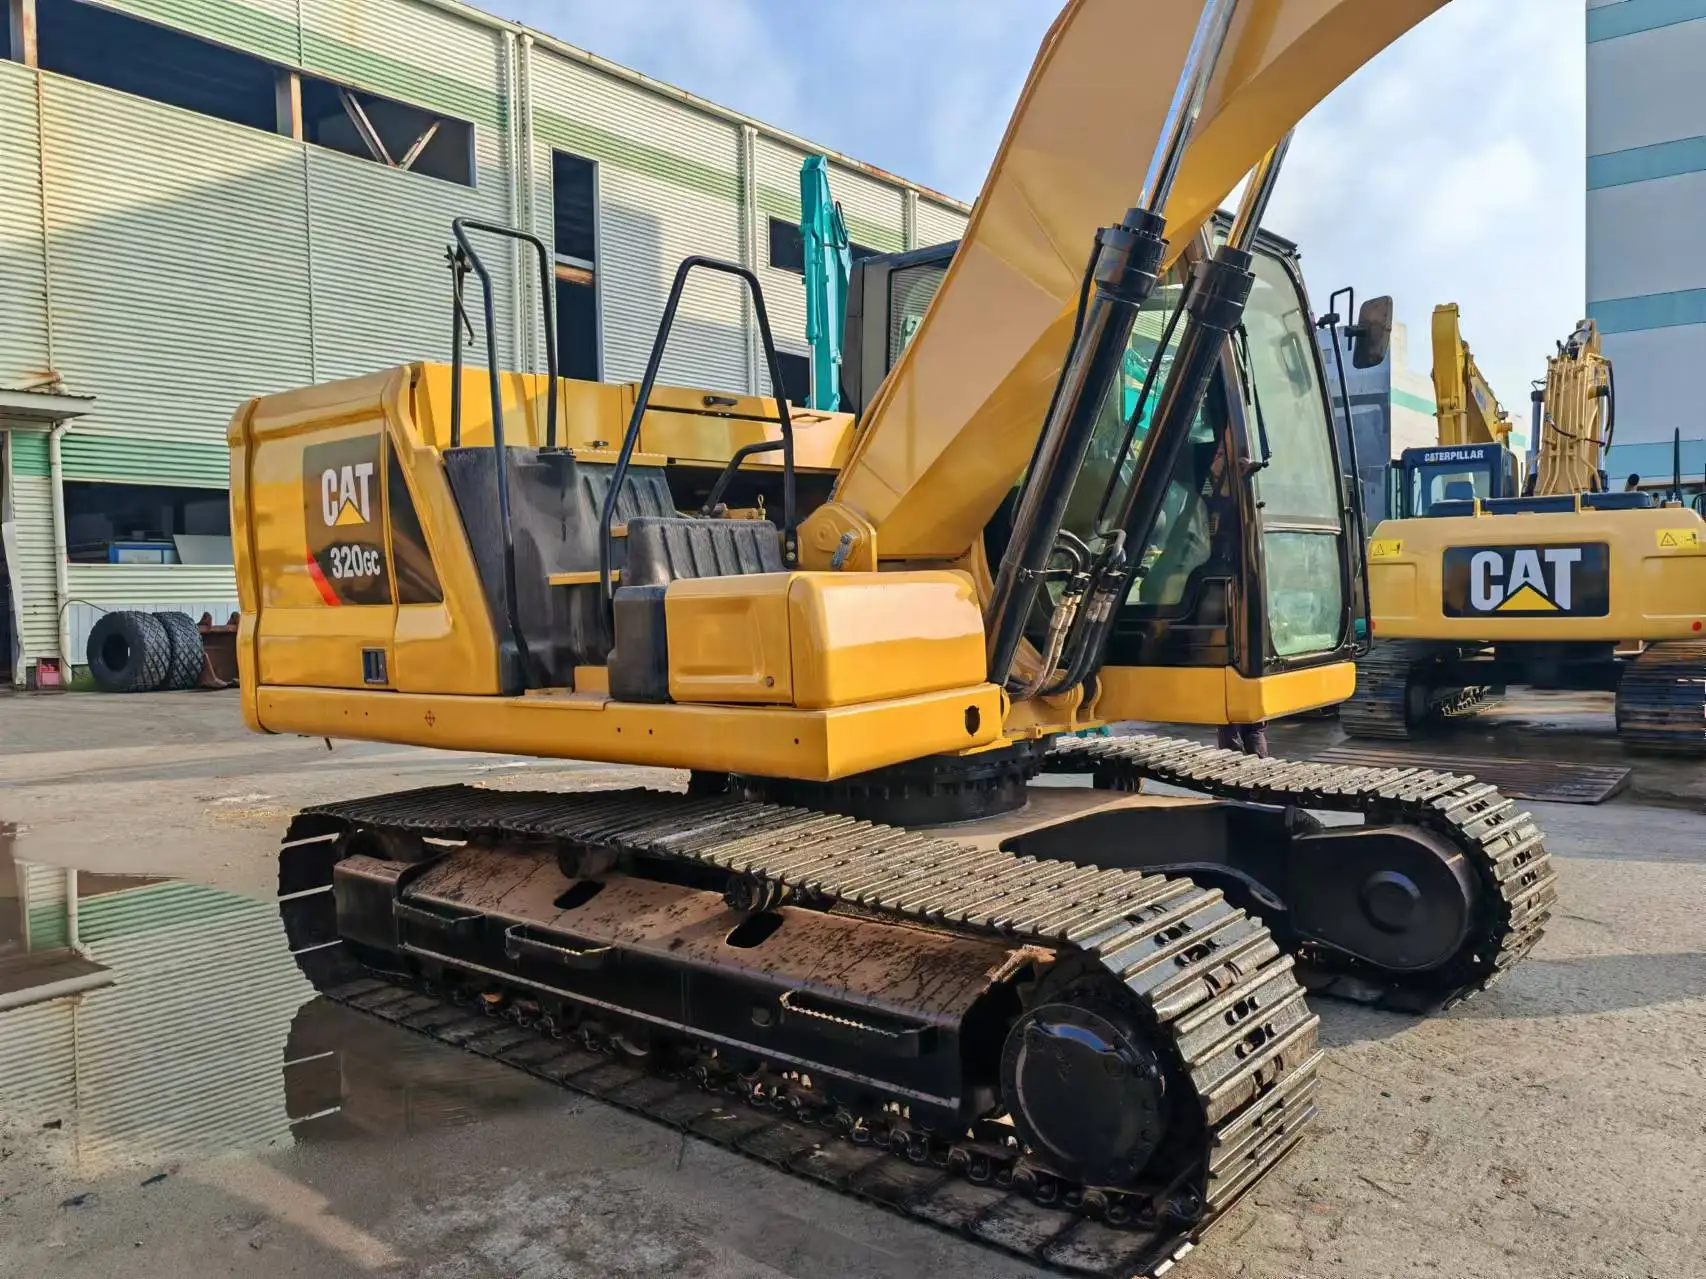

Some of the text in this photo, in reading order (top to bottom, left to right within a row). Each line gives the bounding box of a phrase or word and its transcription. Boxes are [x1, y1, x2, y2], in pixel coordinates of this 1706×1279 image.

[1424, 449, 1484, 462] CATERPILLAR
[321, 462, 373, 527] CAT
[1470, 548, 1582, 611] CAT
